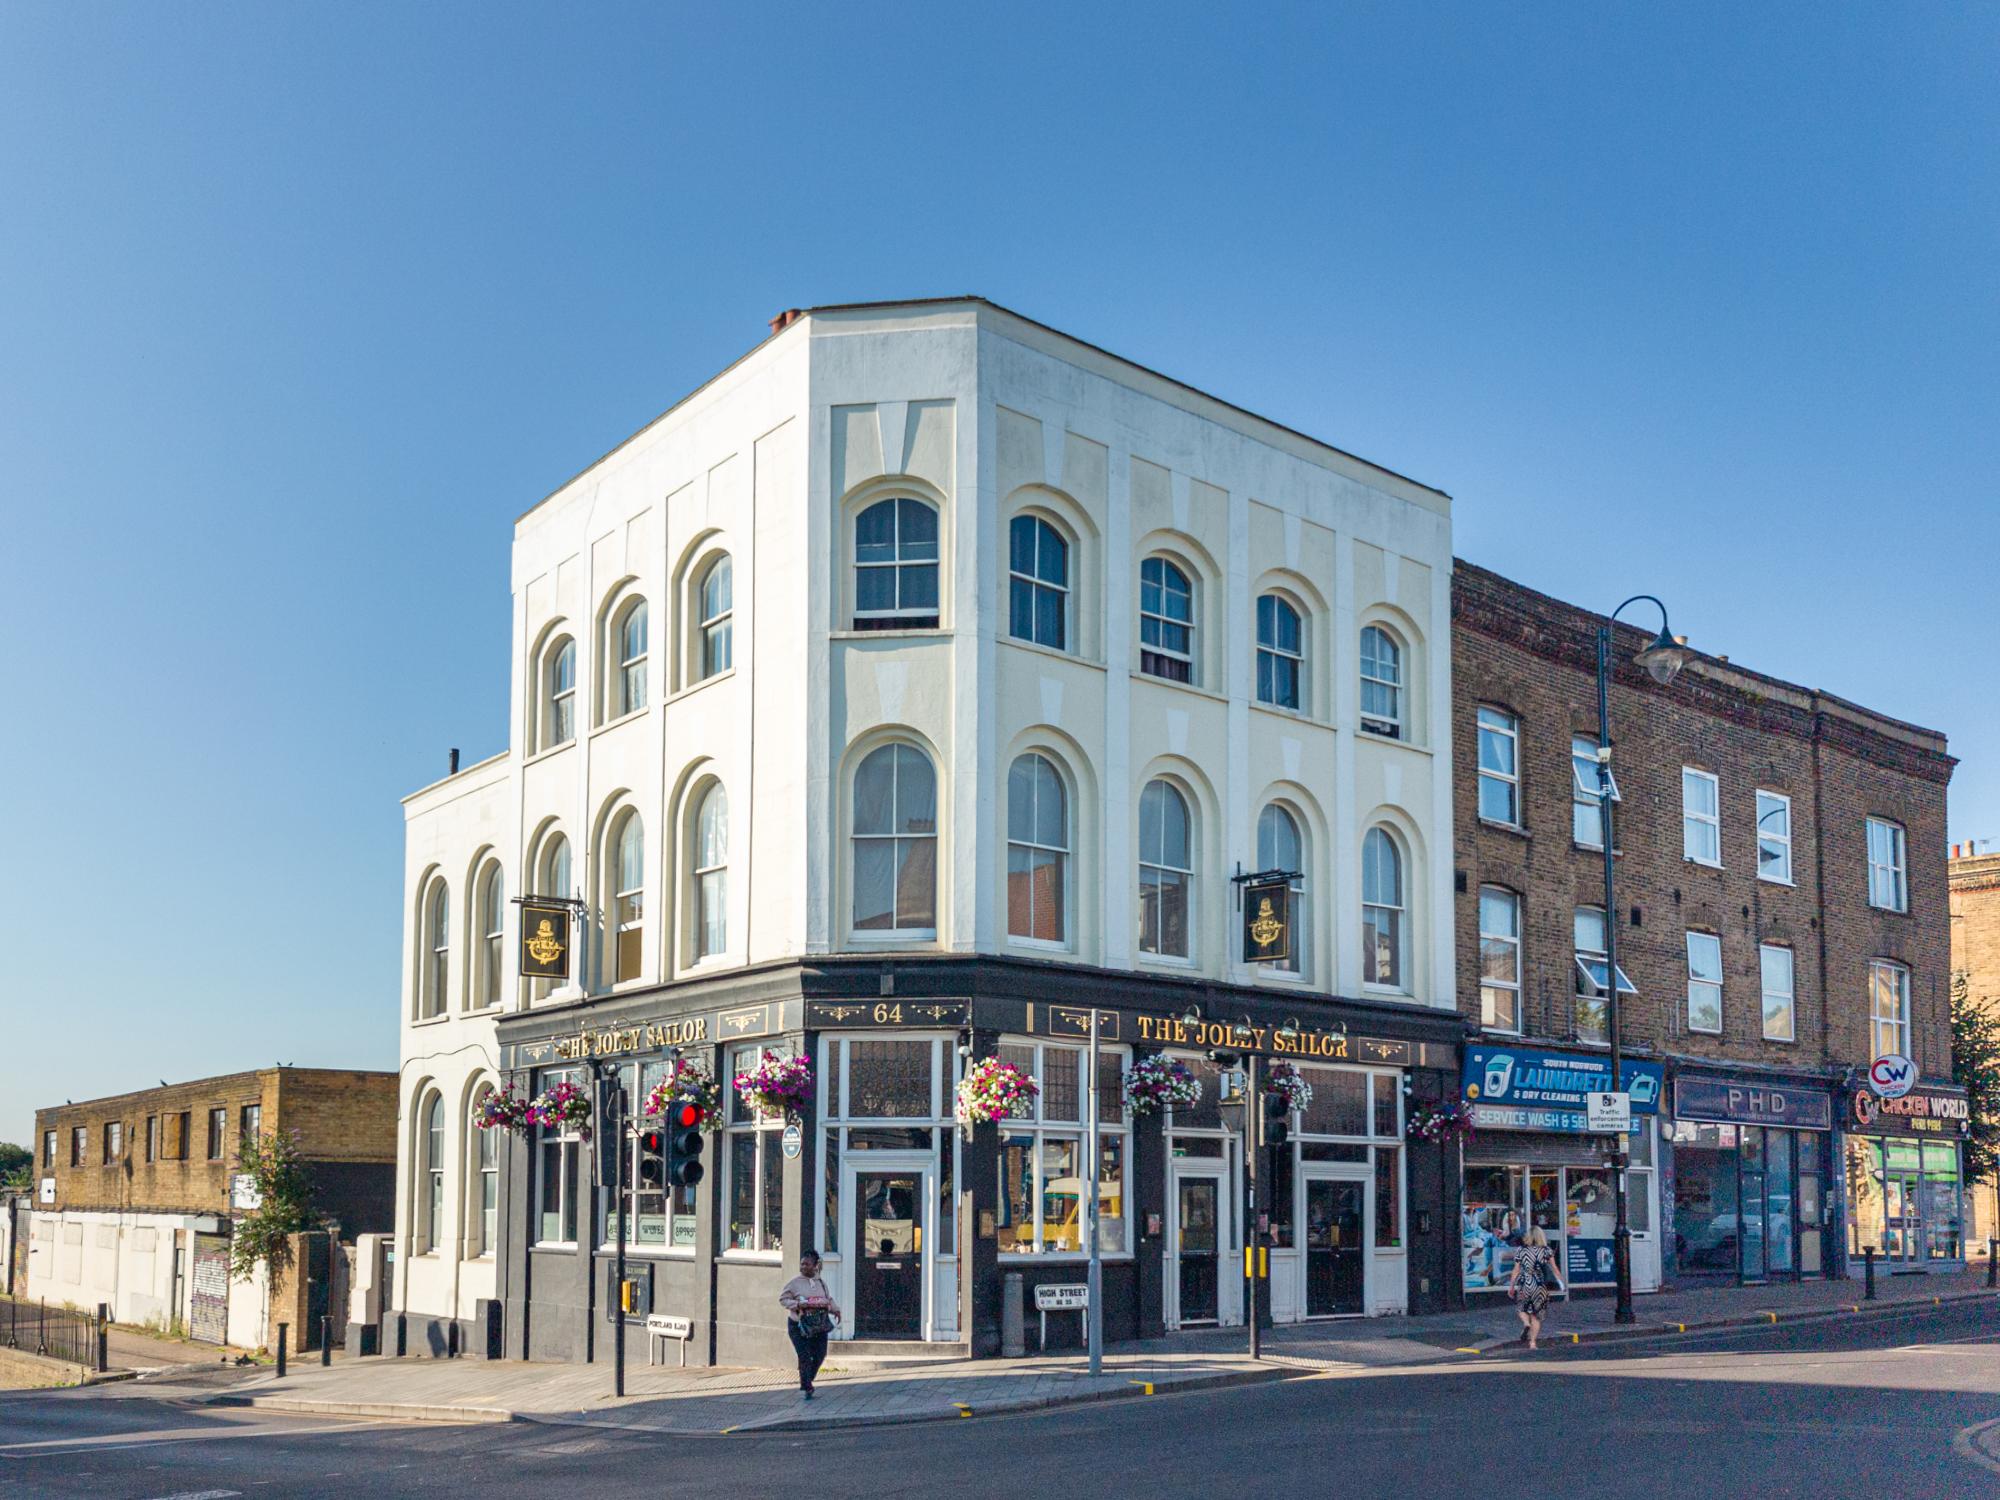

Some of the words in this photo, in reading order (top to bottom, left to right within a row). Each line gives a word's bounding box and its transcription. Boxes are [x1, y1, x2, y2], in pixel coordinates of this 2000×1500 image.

[873, 1003, 903, 1023] 64
[646, 1018, 706, 1047] SAILOR
[1138, 1016, 1187, 1043] THE
[1196, 1022, 1265, 1050] JOLLY
[1273, 1029, 1348, 1058] SAILOR
[1542, 1058, 1568, 1068] SOUTH
[1569, 1060, 1604, 1072] NORWOOD
[1871, 1059, 1909, 1085] CW
[1522, 1091, 1540, 1100] DRY
[1541, 1092, 1581, 1103] CLEANING
[1728, 1088, 1786, 1113] PHD
[1881, 1095, 1929, 1116] CHICKEN
[1930, 1097, 1969, 1119] WORLD
[1479, 1109, 1526, 1126] SERVICE
[1528, 1112, 1559, 1128] WASH
[1561, 1114, 1569, 1128] &
[1571, 1116, 1588, 1130] SEL
[1039, 1288, 1057, 1298] HIGH
[1059, 1288, 1086, 1297] STREET
[649, 1320, 673, 1330] PORTLAND
[674, 1322, 687, 1331] ROAD
